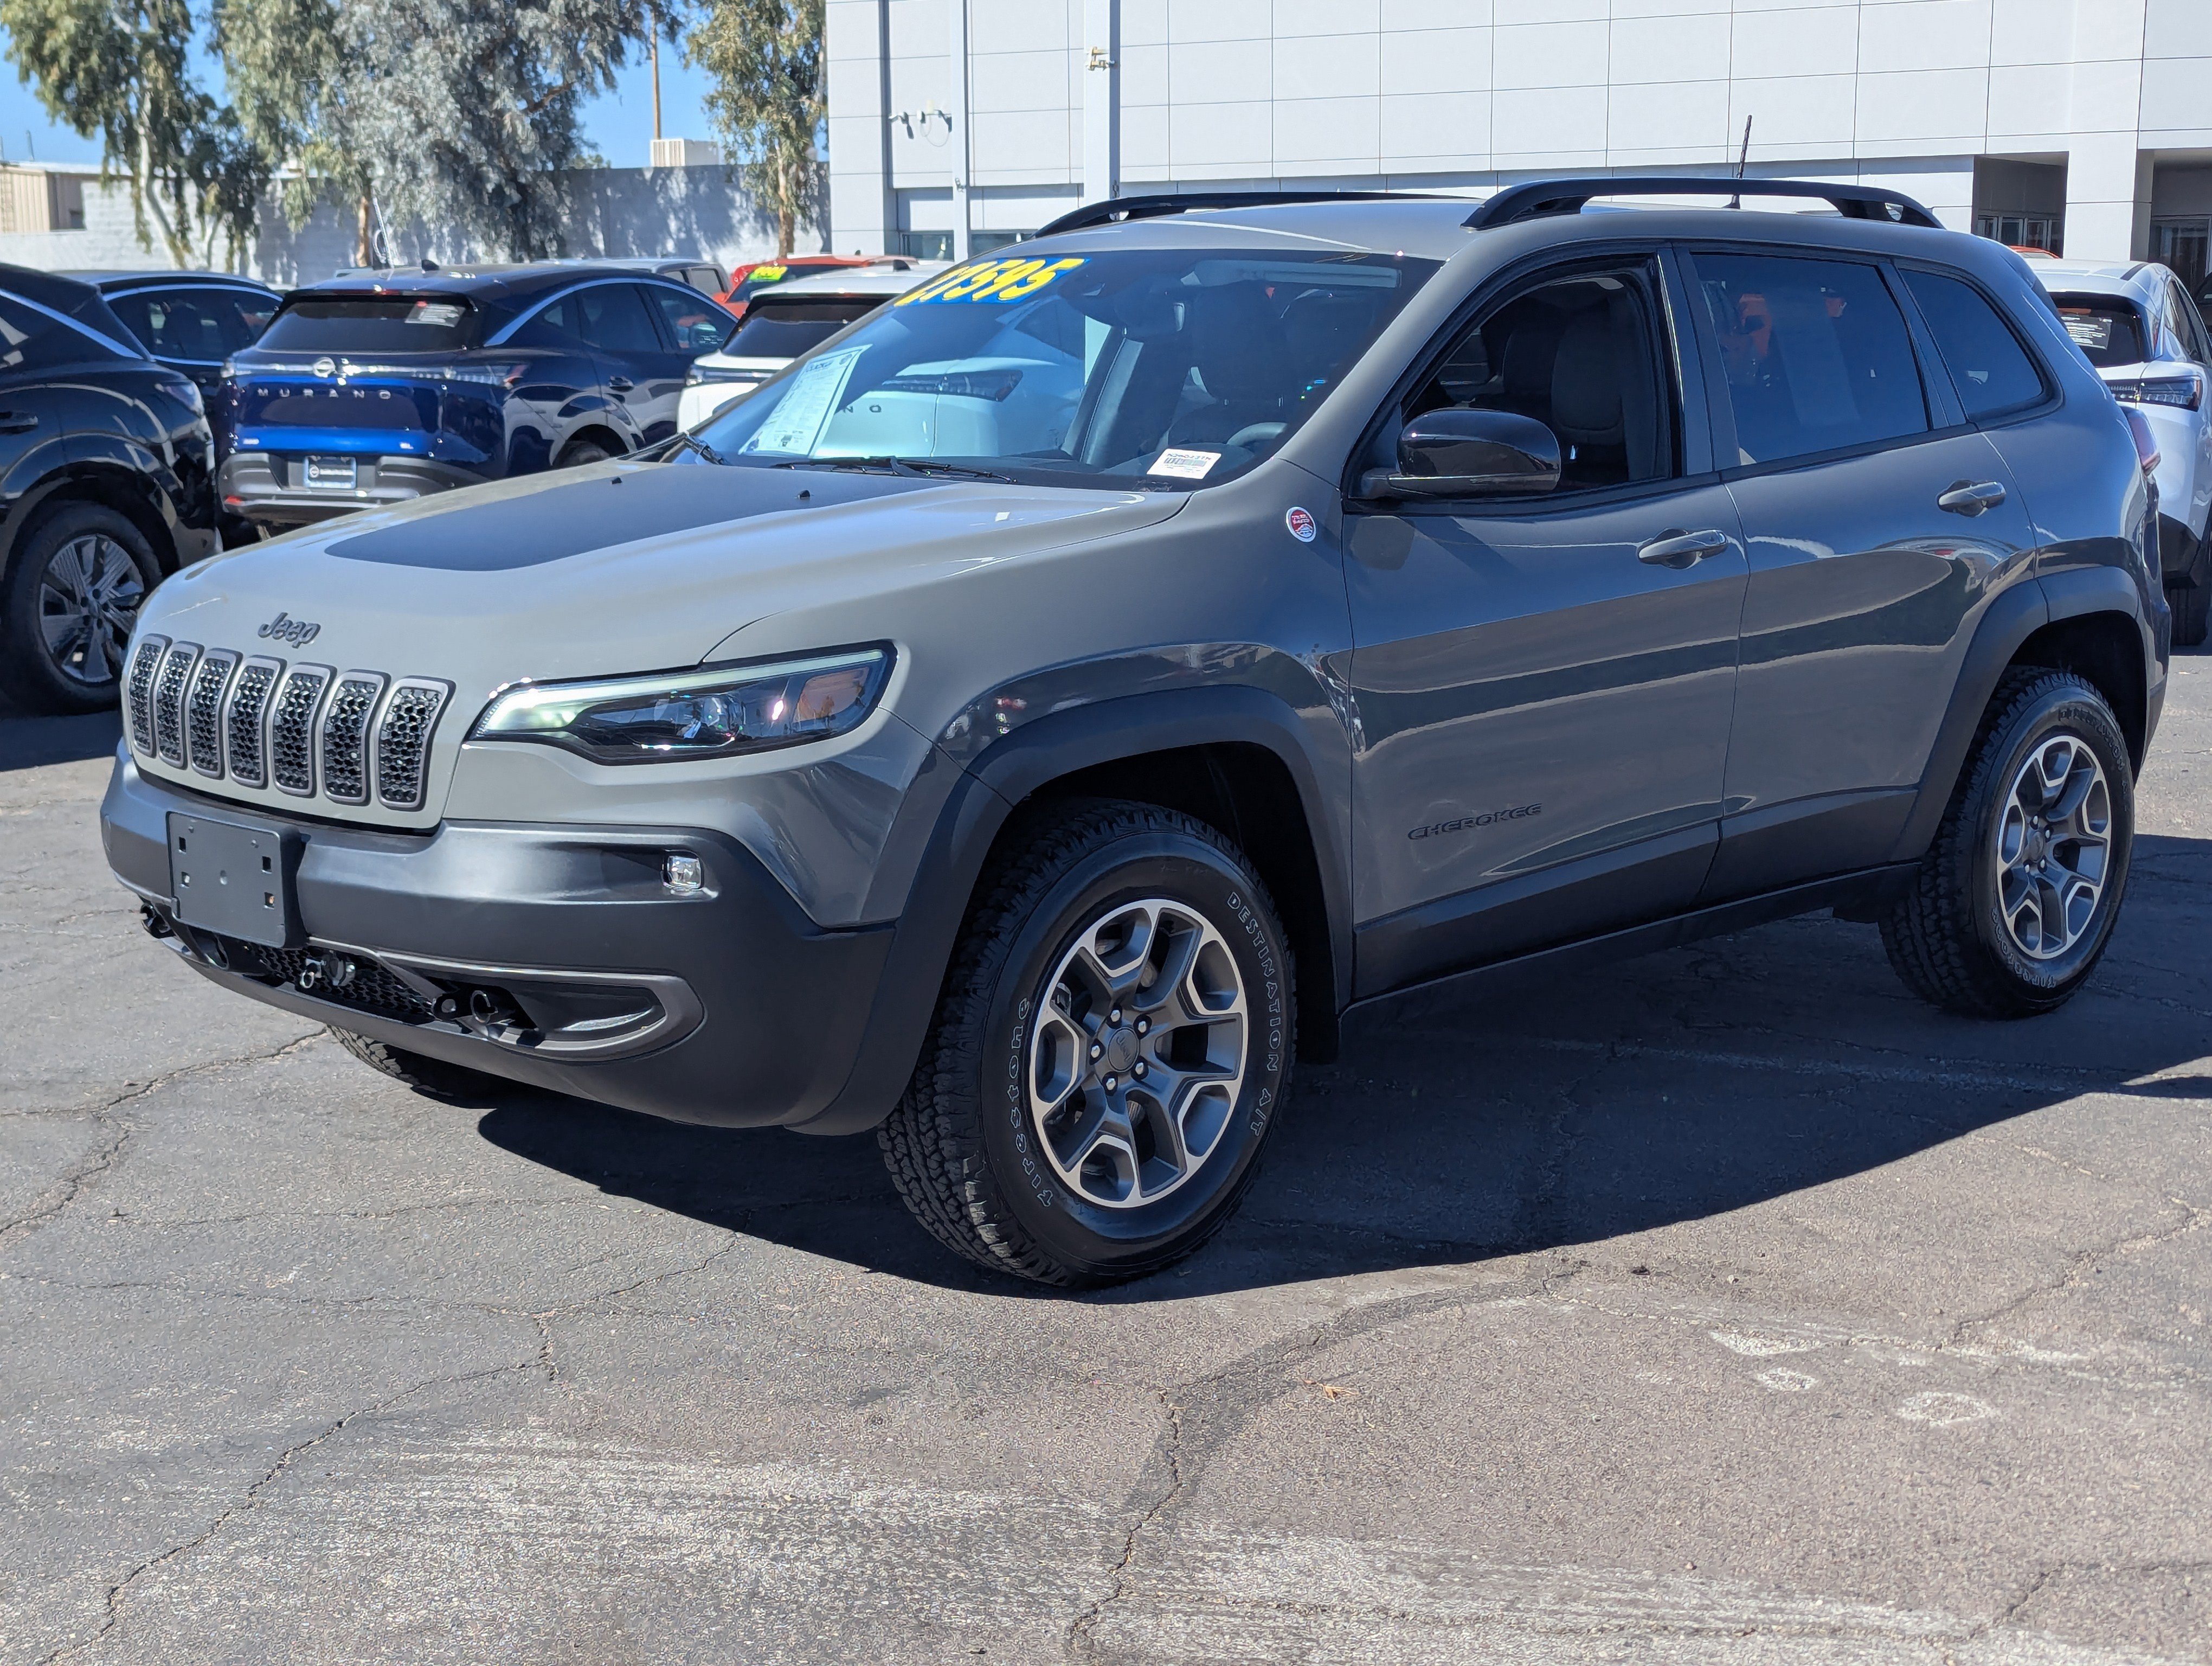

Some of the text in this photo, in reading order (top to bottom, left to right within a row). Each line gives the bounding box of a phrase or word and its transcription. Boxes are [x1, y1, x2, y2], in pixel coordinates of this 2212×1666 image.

[258, 387, 391, 400] MURANO
[258, 612, 321, 649] Jeep
[1407, 803, 1542, 840] CHEROKEE
[1227, 892, 1281, 1137] DESTINATION A/T
[1007, 997, 1053, 1207] Firestone
